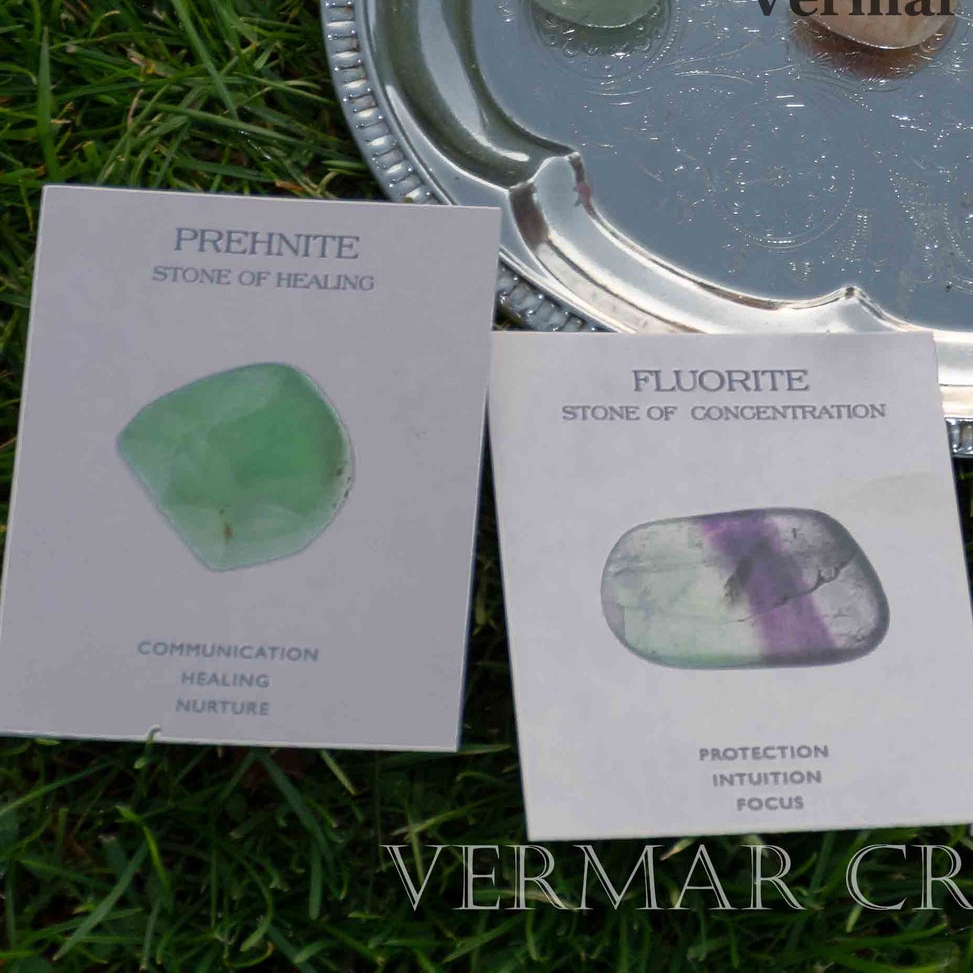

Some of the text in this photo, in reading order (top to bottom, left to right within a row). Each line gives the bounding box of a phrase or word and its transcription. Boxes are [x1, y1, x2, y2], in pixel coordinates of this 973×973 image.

[174, 227, 359, 260] PREHNITE
[152, 265, 375, 292] STONE OF HEALING
[633, 368, 809, 393] FLUORITE
[562, 403, 886, 421] STONE OF CONCENTRATION
[137, 640, 319, 662] COMMUNICATION
[180, 670, 270, 689] HEALING
[175, 698, 270, 716] NURTURE
[699, 745, 829, 762] PROTECTION
[712, 770, 822, 787] INTUITION
[736, 796, 804, 811] FOCUS
